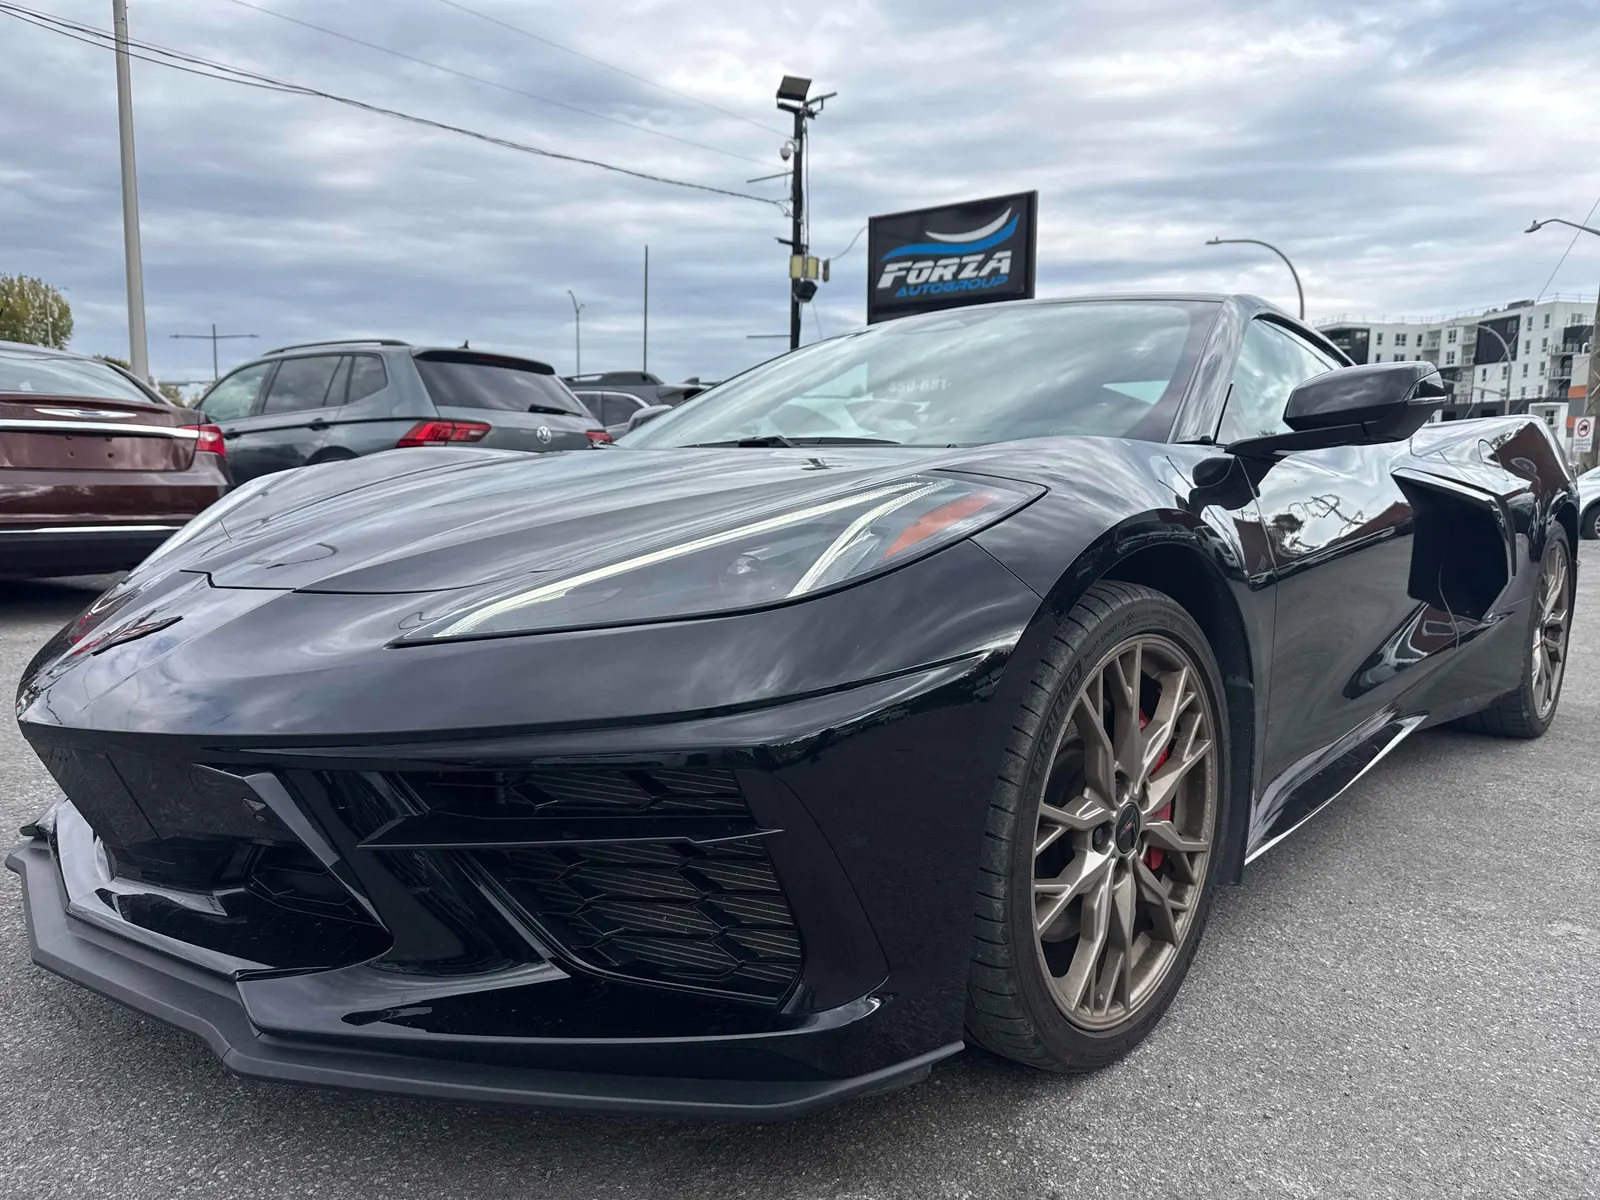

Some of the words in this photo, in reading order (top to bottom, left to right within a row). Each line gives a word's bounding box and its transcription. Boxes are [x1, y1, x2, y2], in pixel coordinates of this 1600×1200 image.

[877, 251, 1012, 289] FORZA
[895, 275, 1008, 297] AUTOGROUP
[1101, 624, 1117, 644] SPORT
[1033, 667, 1080, 775] MICHELIN
